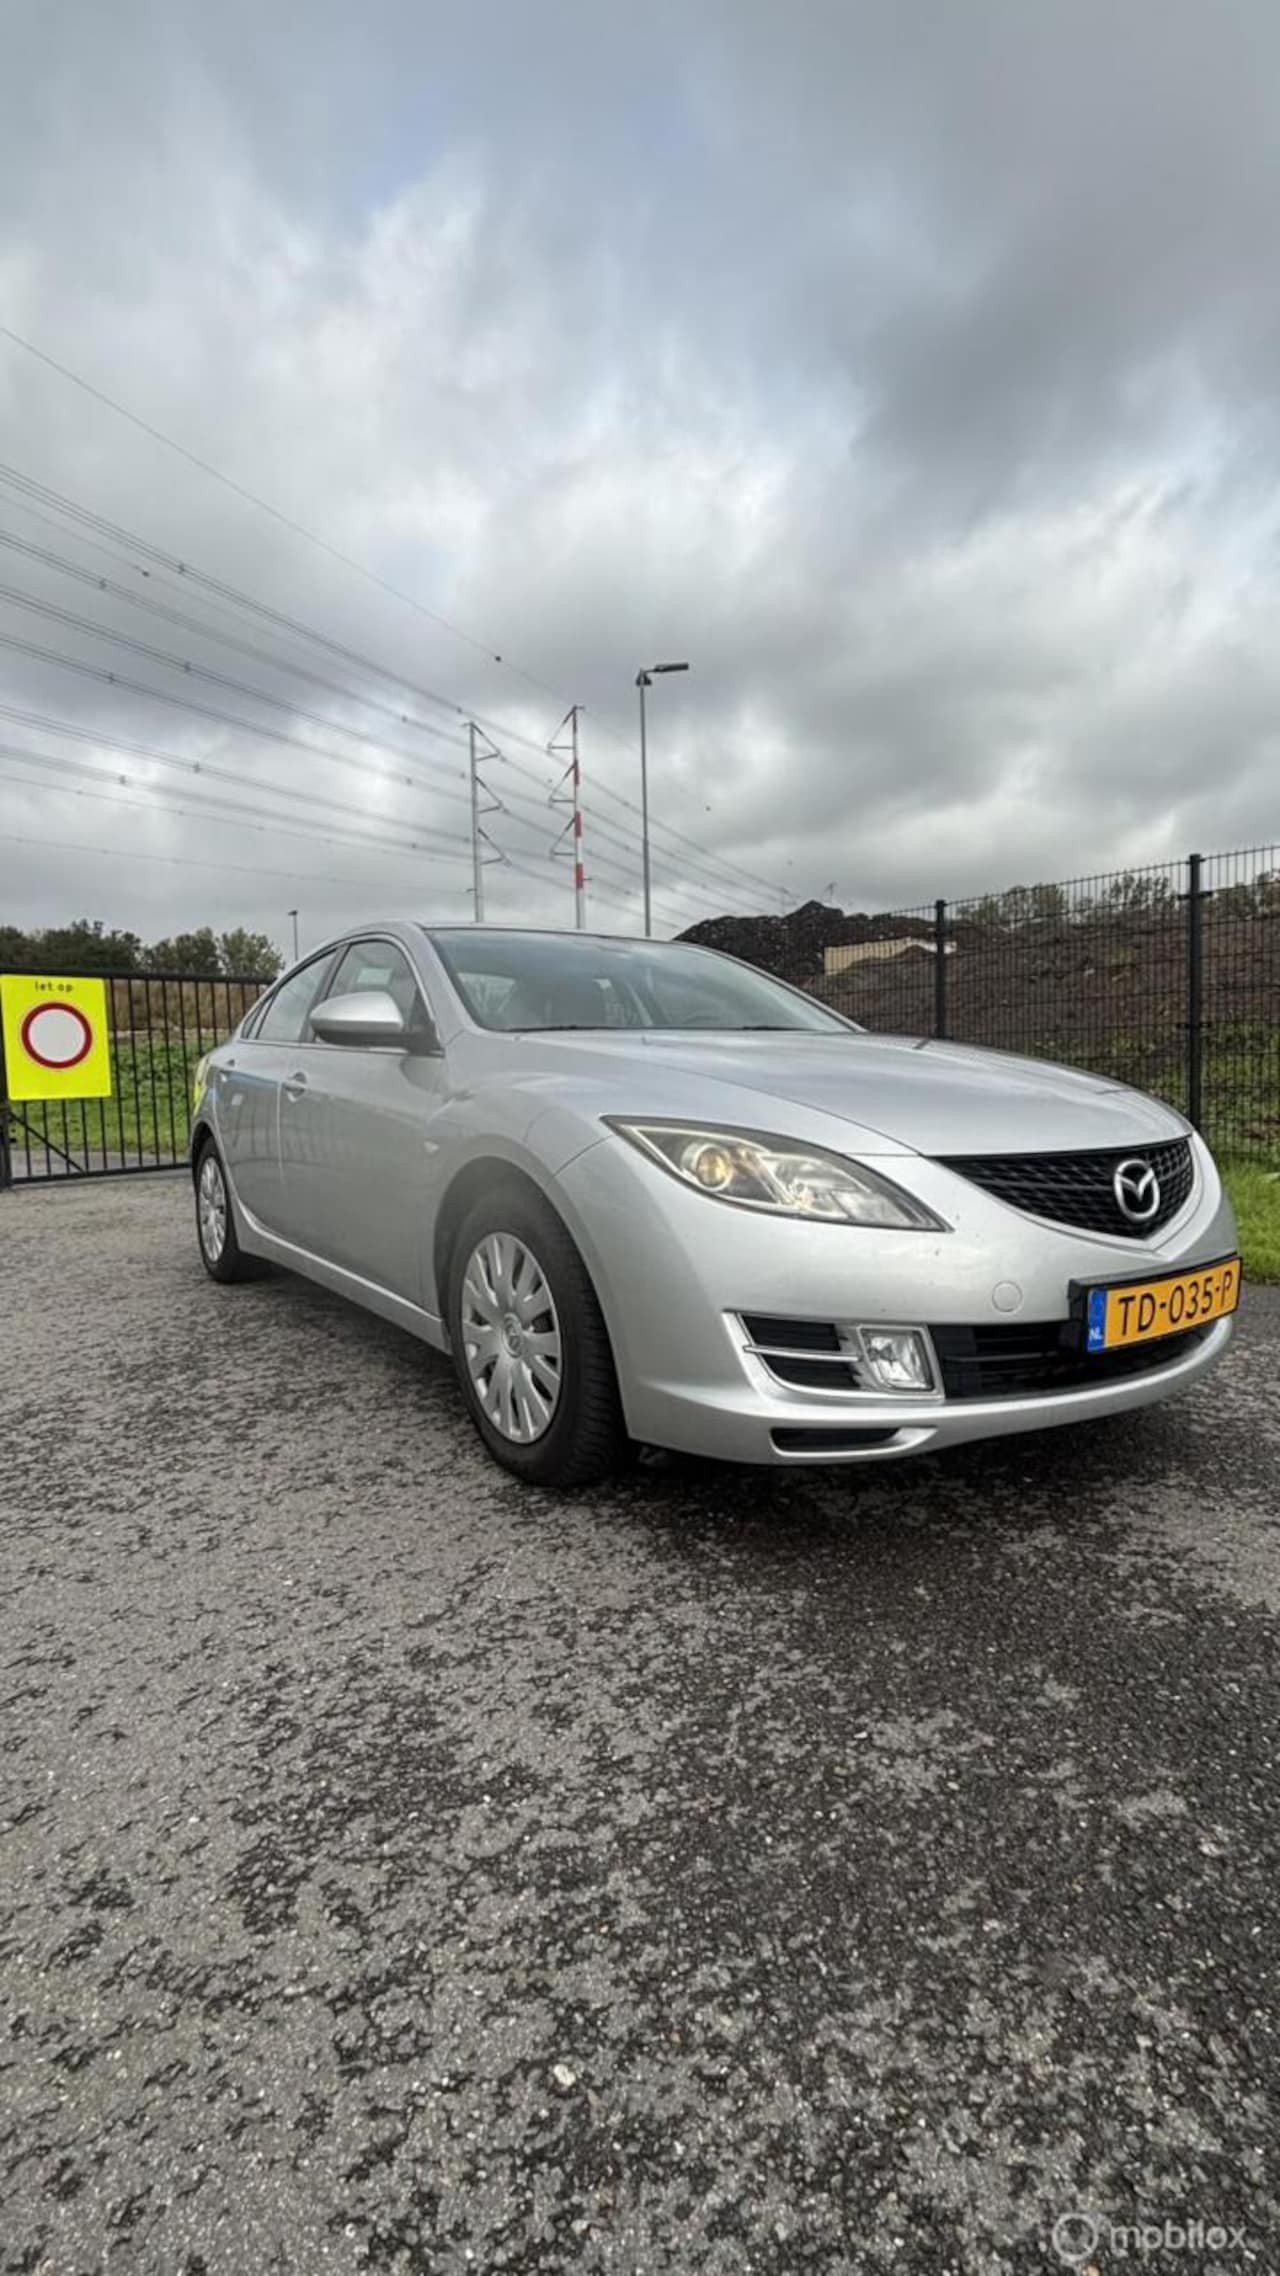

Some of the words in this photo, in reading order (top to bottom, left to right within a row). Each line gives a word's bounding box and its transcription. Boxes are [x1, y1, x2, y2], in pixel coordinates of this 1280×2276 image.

[34, 981, 53, 991] let
[57, 983, 73, 993] op
[1118, 1270, 1233, 1336] TD-035-P
[1089, 1327, 1102, 1341] NL
